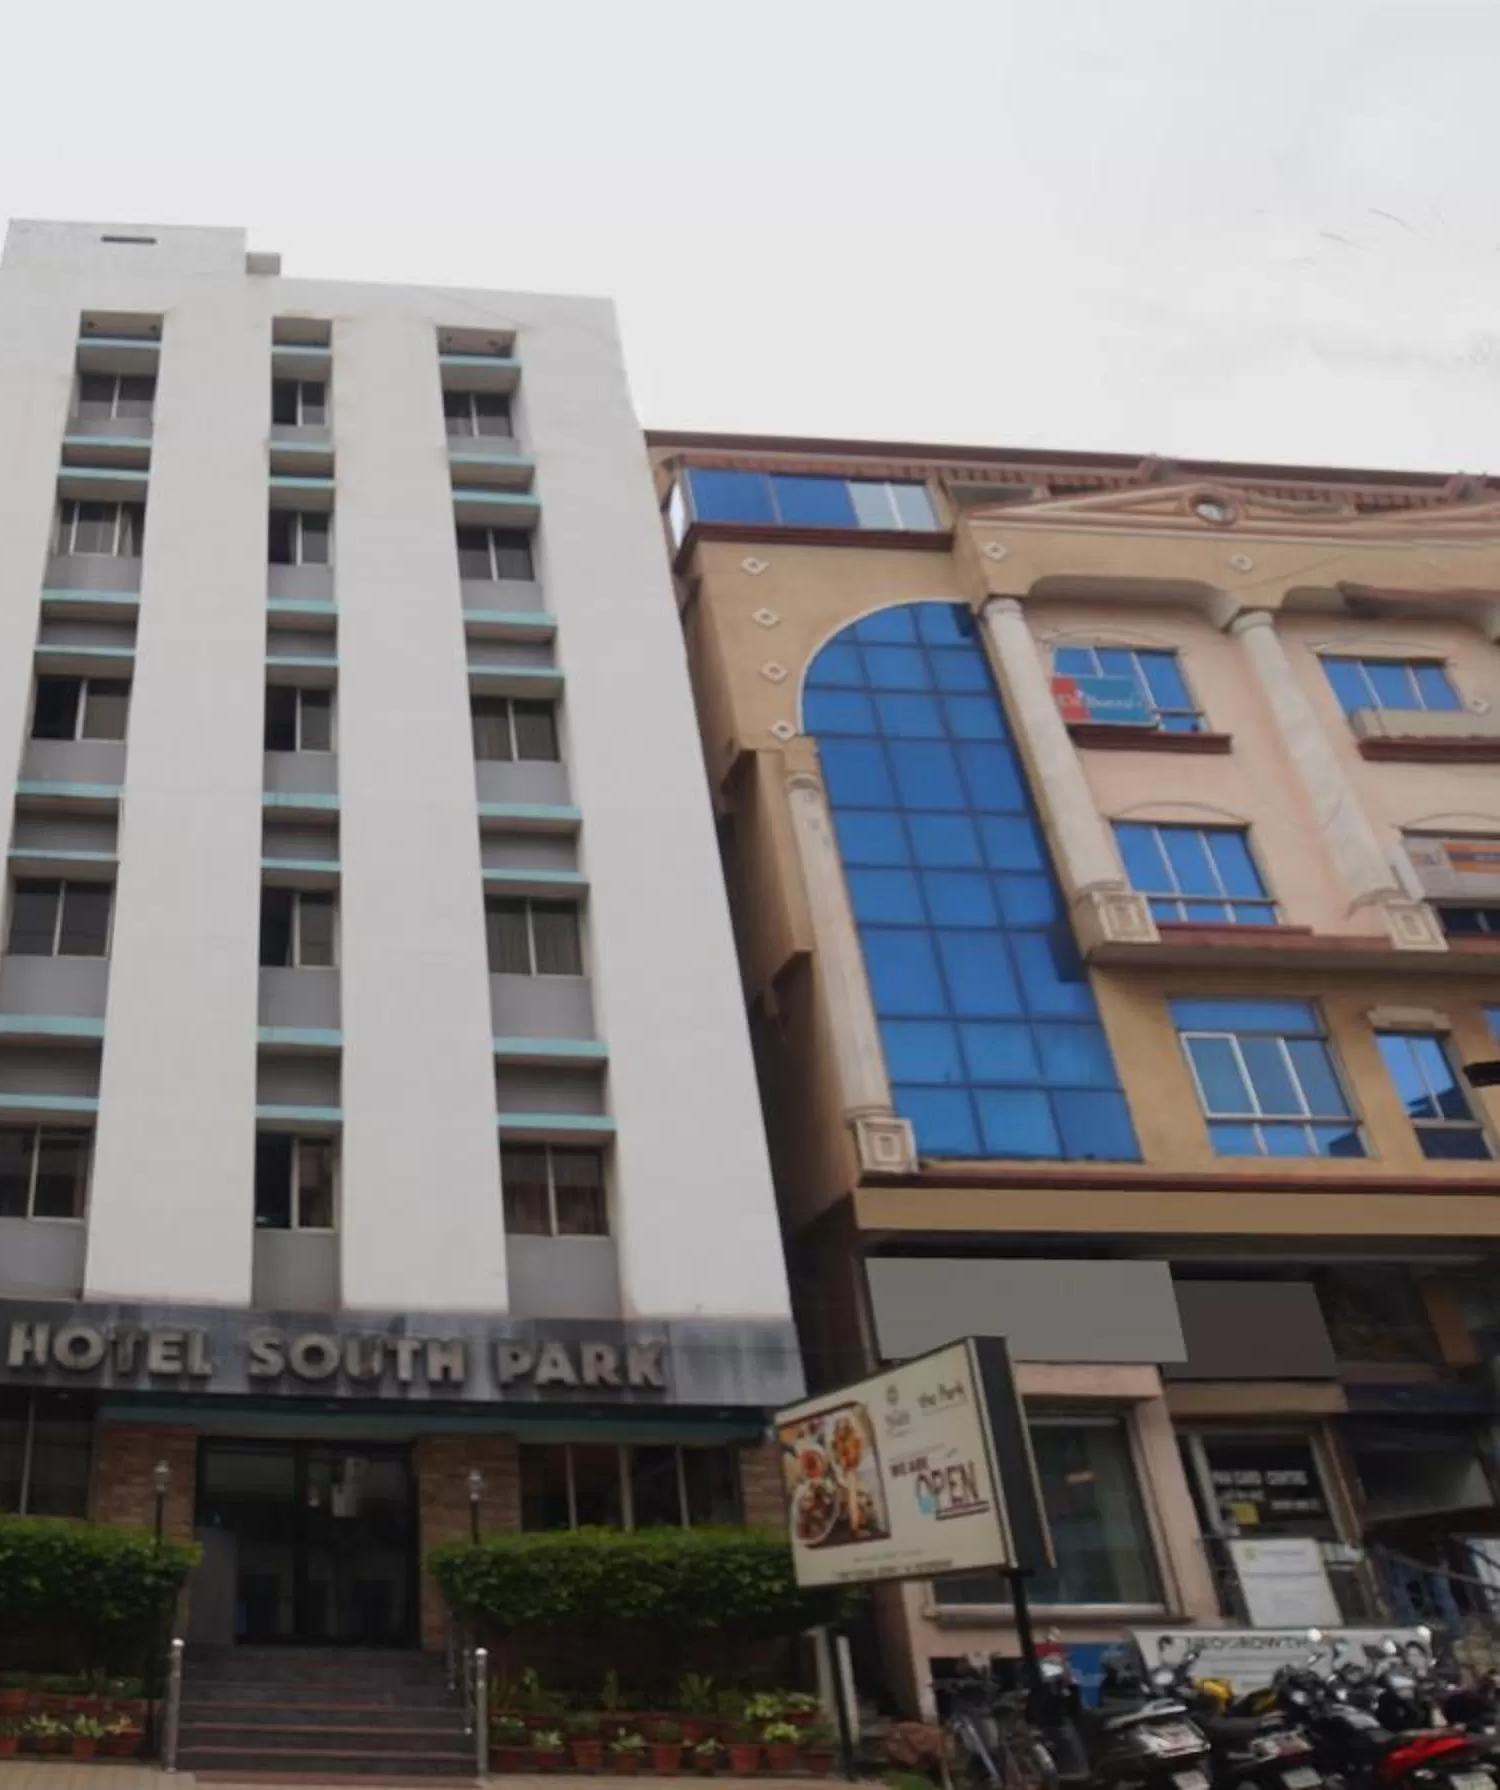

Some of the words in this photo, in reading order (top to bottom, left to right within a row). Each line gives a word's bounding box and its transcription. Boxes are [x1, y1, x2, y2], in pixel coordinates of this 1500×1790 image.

[7, 1320, 213, 1376] HOTEL
[248, 1327, 466, 1383] SOUTH
[501, 1337, 668, 1388] PARK
[915, 1460, 980, 1513] OPEN
